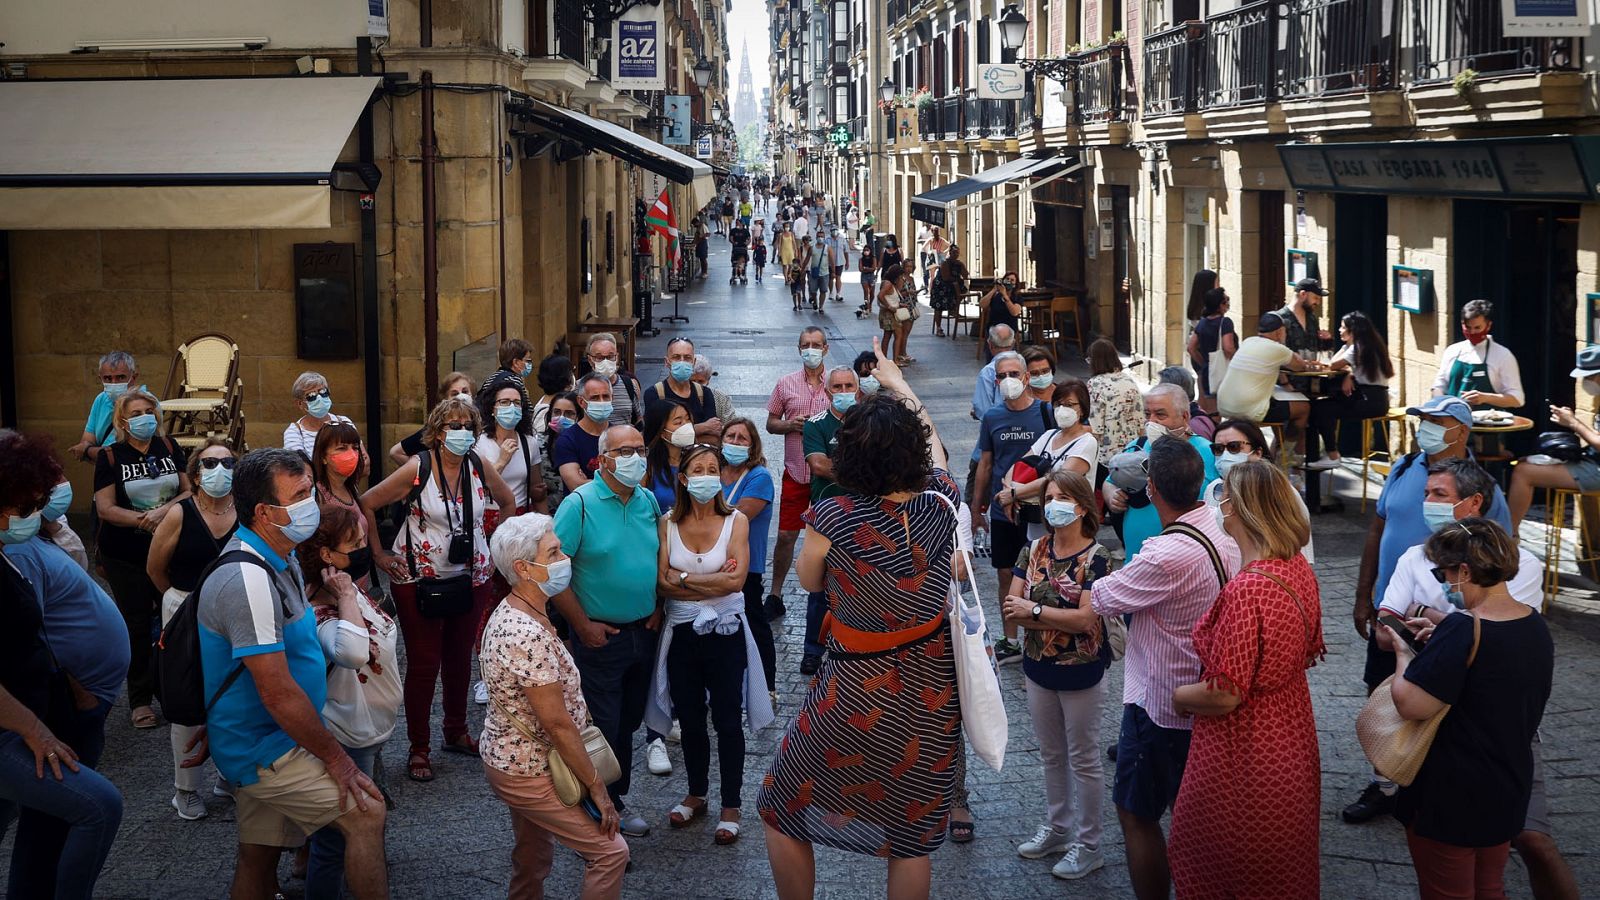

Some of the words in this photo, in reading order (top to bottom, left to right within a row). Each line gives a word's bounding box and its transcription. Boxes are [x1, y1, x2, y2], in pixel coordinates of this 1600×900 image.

[620, 37, 655, 58] az
[1332, 159, 1369, 177] CASA
[1372, 159, 1446, 180] VERGARA
[1453, 159, 1494, 178] 1948
[1000, 432, 1035, 441] OPTIMIST
